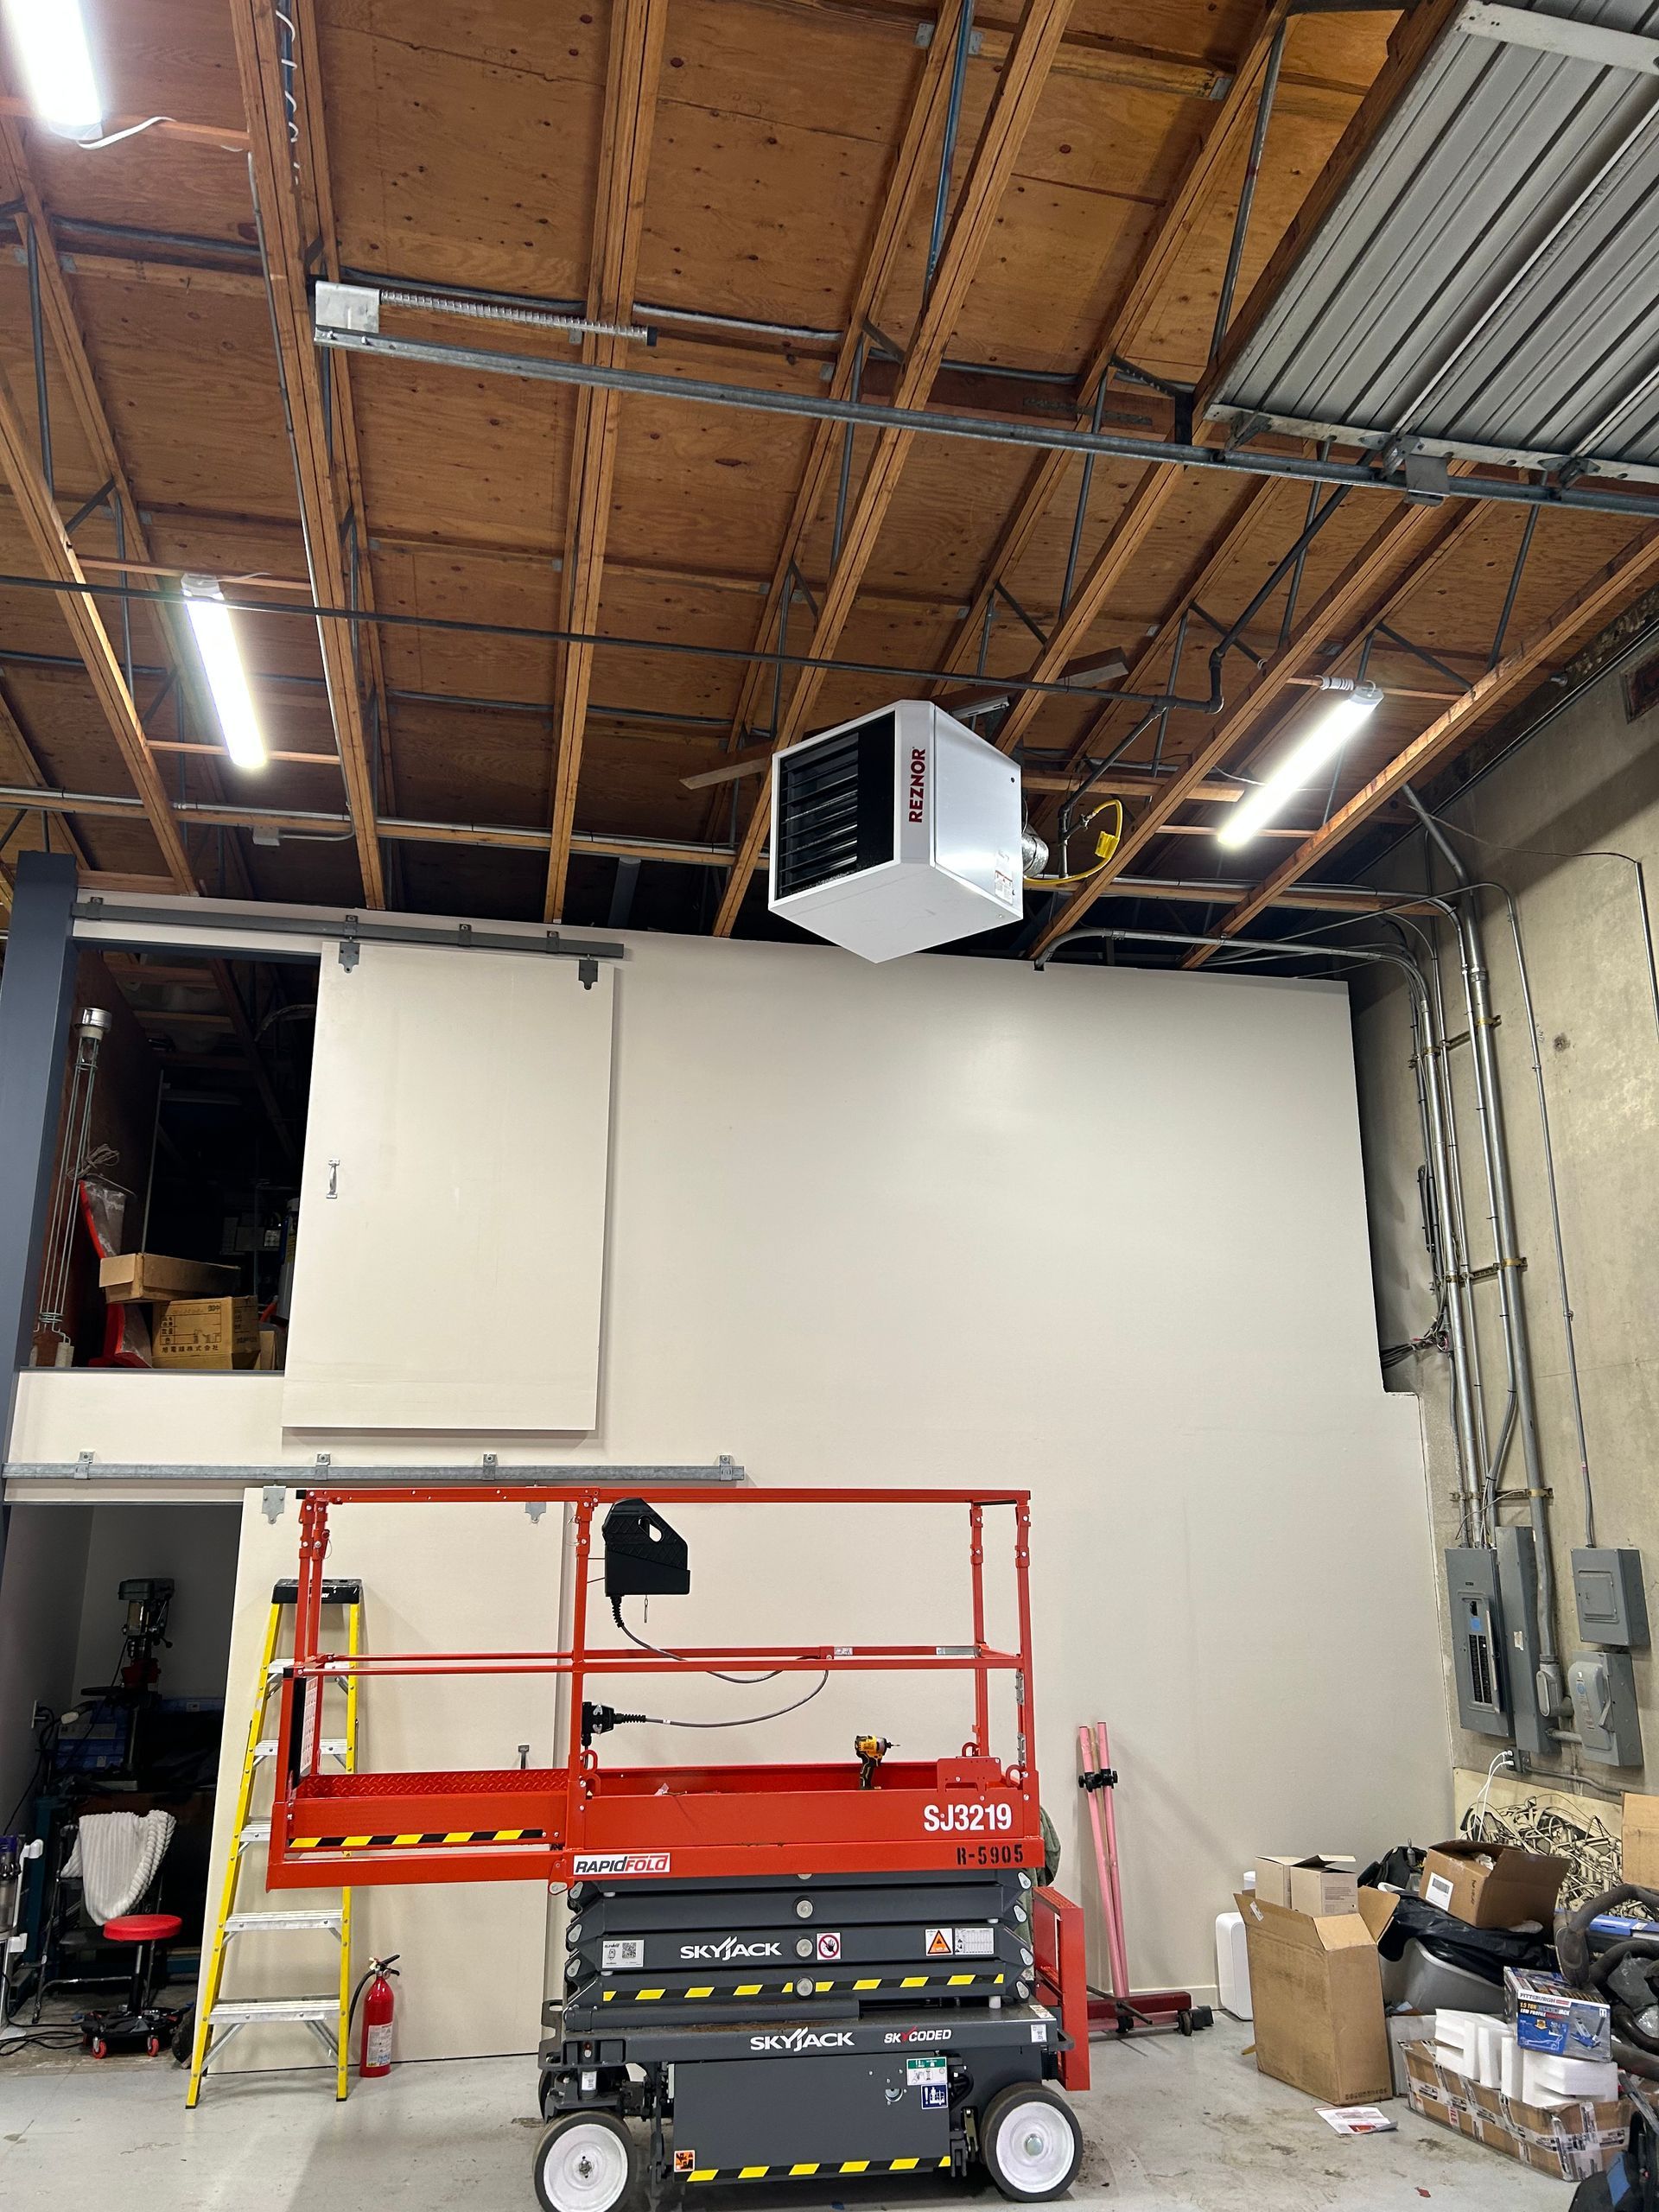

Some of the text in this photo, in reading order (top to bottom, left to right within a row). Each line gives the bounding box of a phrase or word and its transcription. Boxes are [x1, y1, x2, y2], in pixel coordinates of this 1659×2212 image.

[908, 748, 926, 823] REZNOR
[924, 1803, 1012, 1832] SJ3219
[957, 1844, 1024, 1866] R-5905
[680, 1936, 782, 1961] SKYJACK
[1520, 1993, 1556, 2003] PITTSBURGH
[750, 2026, 855, 2052] SKYJACK
